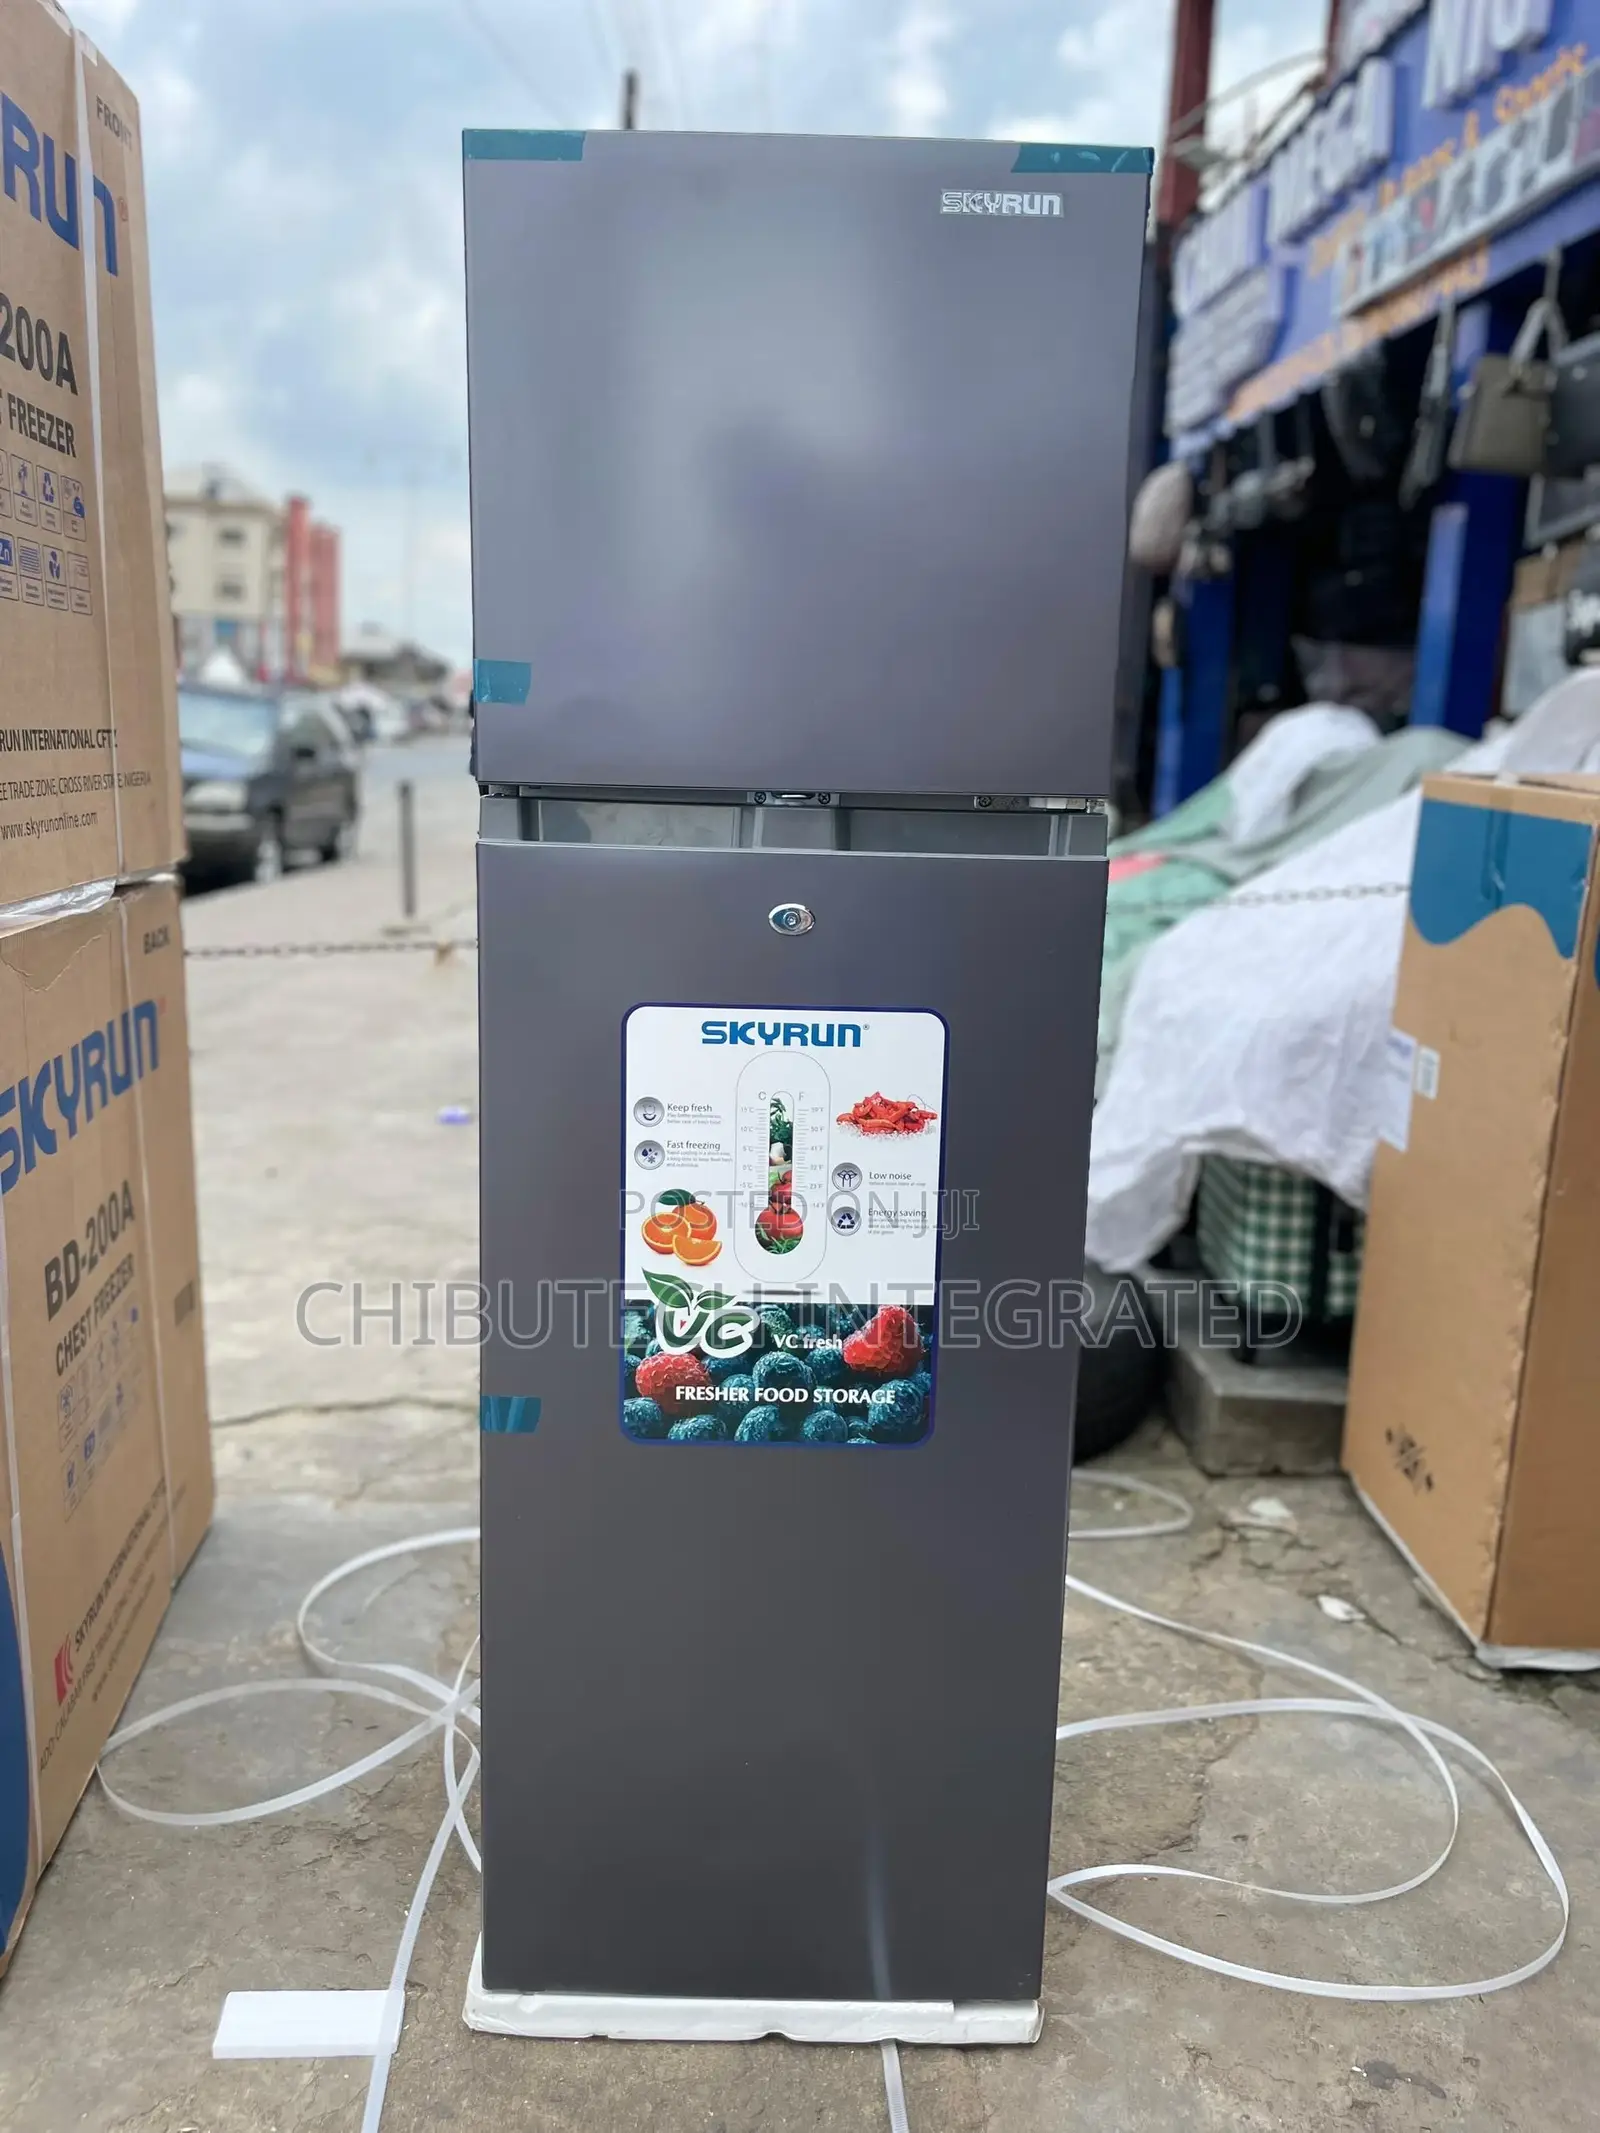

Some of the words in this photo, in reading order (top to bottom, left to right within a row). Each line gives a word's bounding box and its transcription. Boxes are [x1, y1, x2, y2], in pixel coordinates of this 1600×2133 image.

[943, 192, 1060, 215] SKYRUN
[8, 392, 76, 458] FREEZER
[22, 729, 95, 751] INTERNATIONAL
[8, 780, 35, 799] TRADE
[59, 775, 82, 794] CROSS
[0, 999, 159, 1195] SKYRUN
[667, 1103, 689, 1112] Keep
[691, 1103, 712, 1112] fresh
[667, 1140, 683, 1149] Fast
[686, 1140, 721, 1151] freezing
[869, 1172, 887, 1180] Low
[889, 1172, 912, 1180] noise
[868, 1209, 897, 1218] Energy
[899, 1209, 927, 1218] saving
[44, 1179, 135, 1322] BD-200A
[55, 1305, 93, 1376] CHEST
[773, 1334, 798, 1349] VC
[803, 1334, 842, 1349] fresh
[675, 1385, 749, 1401] FRESHER
[754, 1387, 808, 1403] FOOD
[813, 1387, 895, 1404] STORAGE
